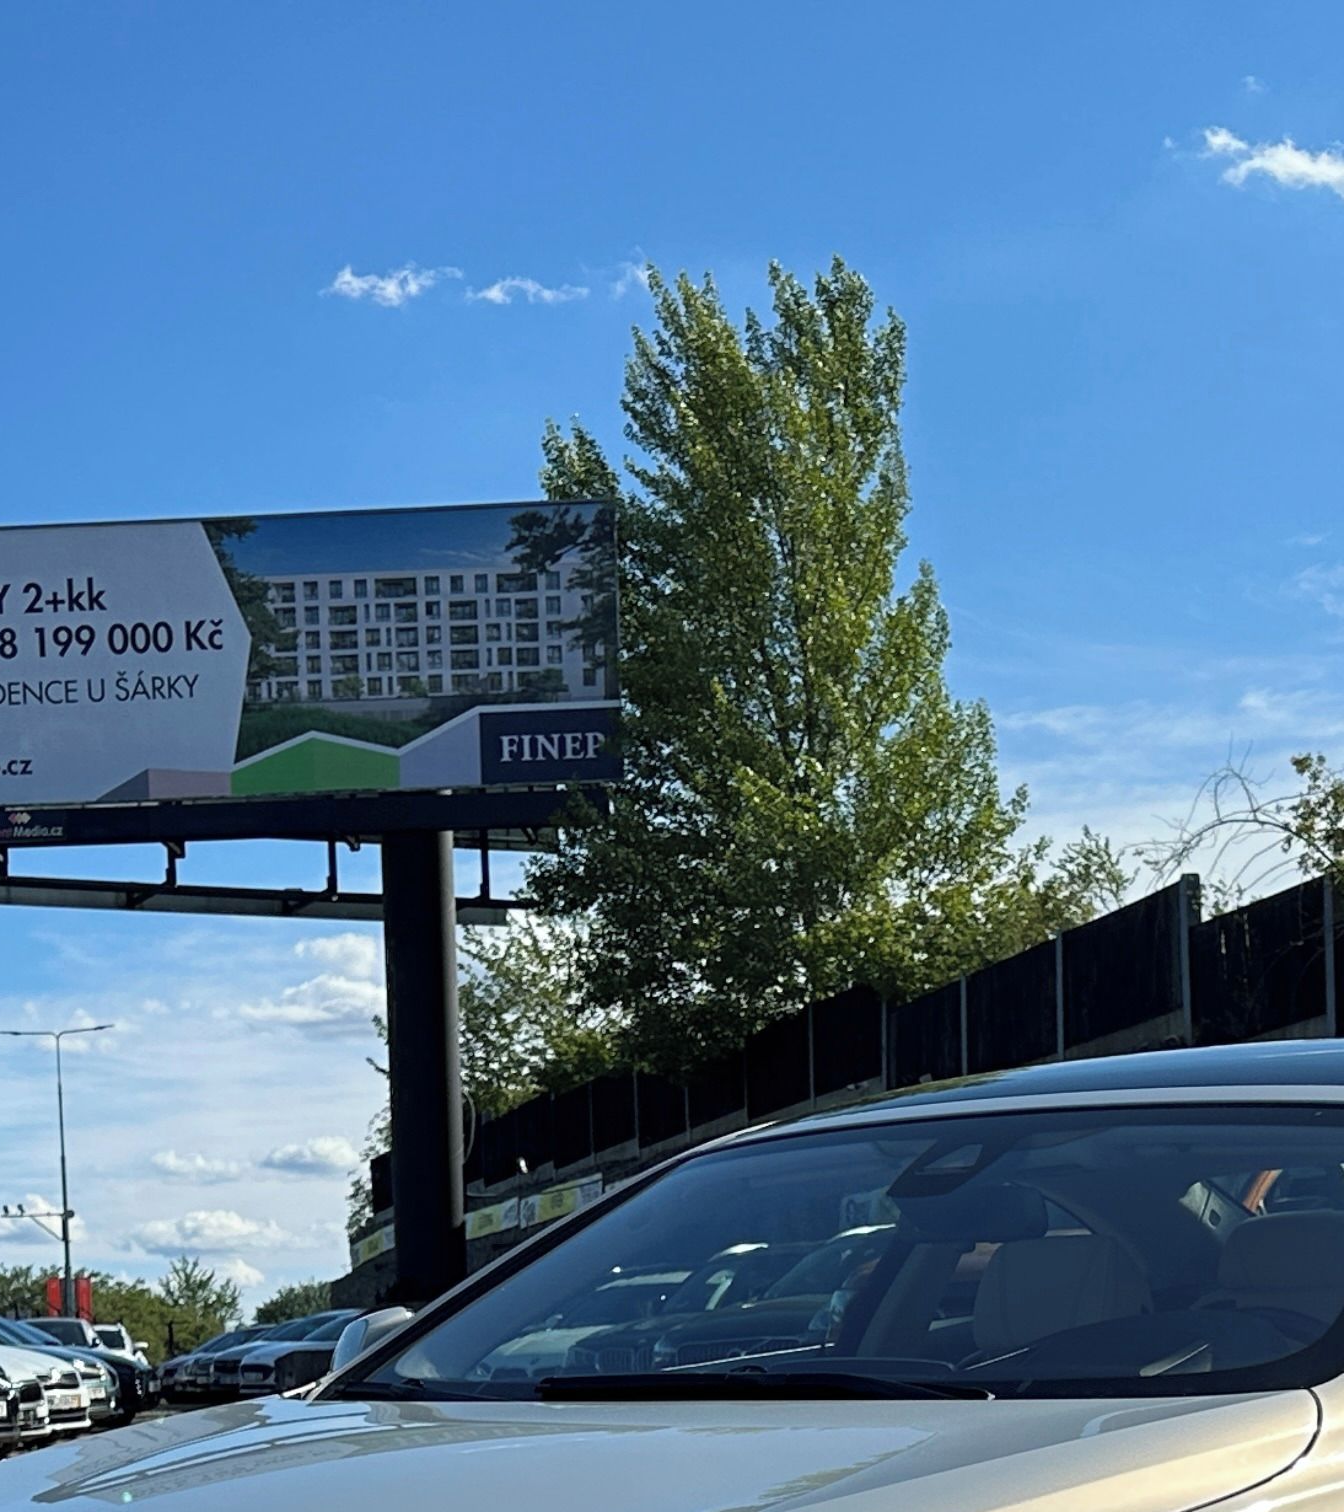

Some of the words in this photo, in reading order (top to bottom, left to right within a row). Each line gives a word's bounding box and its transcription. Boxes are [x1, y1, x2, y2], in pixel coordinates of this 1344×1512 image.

[22, 577, 107, 614] 2+kk
[34, 625, 96, 658] 199
[108, 621, 173, 655] 000
[184, 619, 224, 651] Kč
[87, 678, 106, 702] U
[114, 670, 199, 702] ŠÁRKY
[499, 731, 606, 762] FINEP
